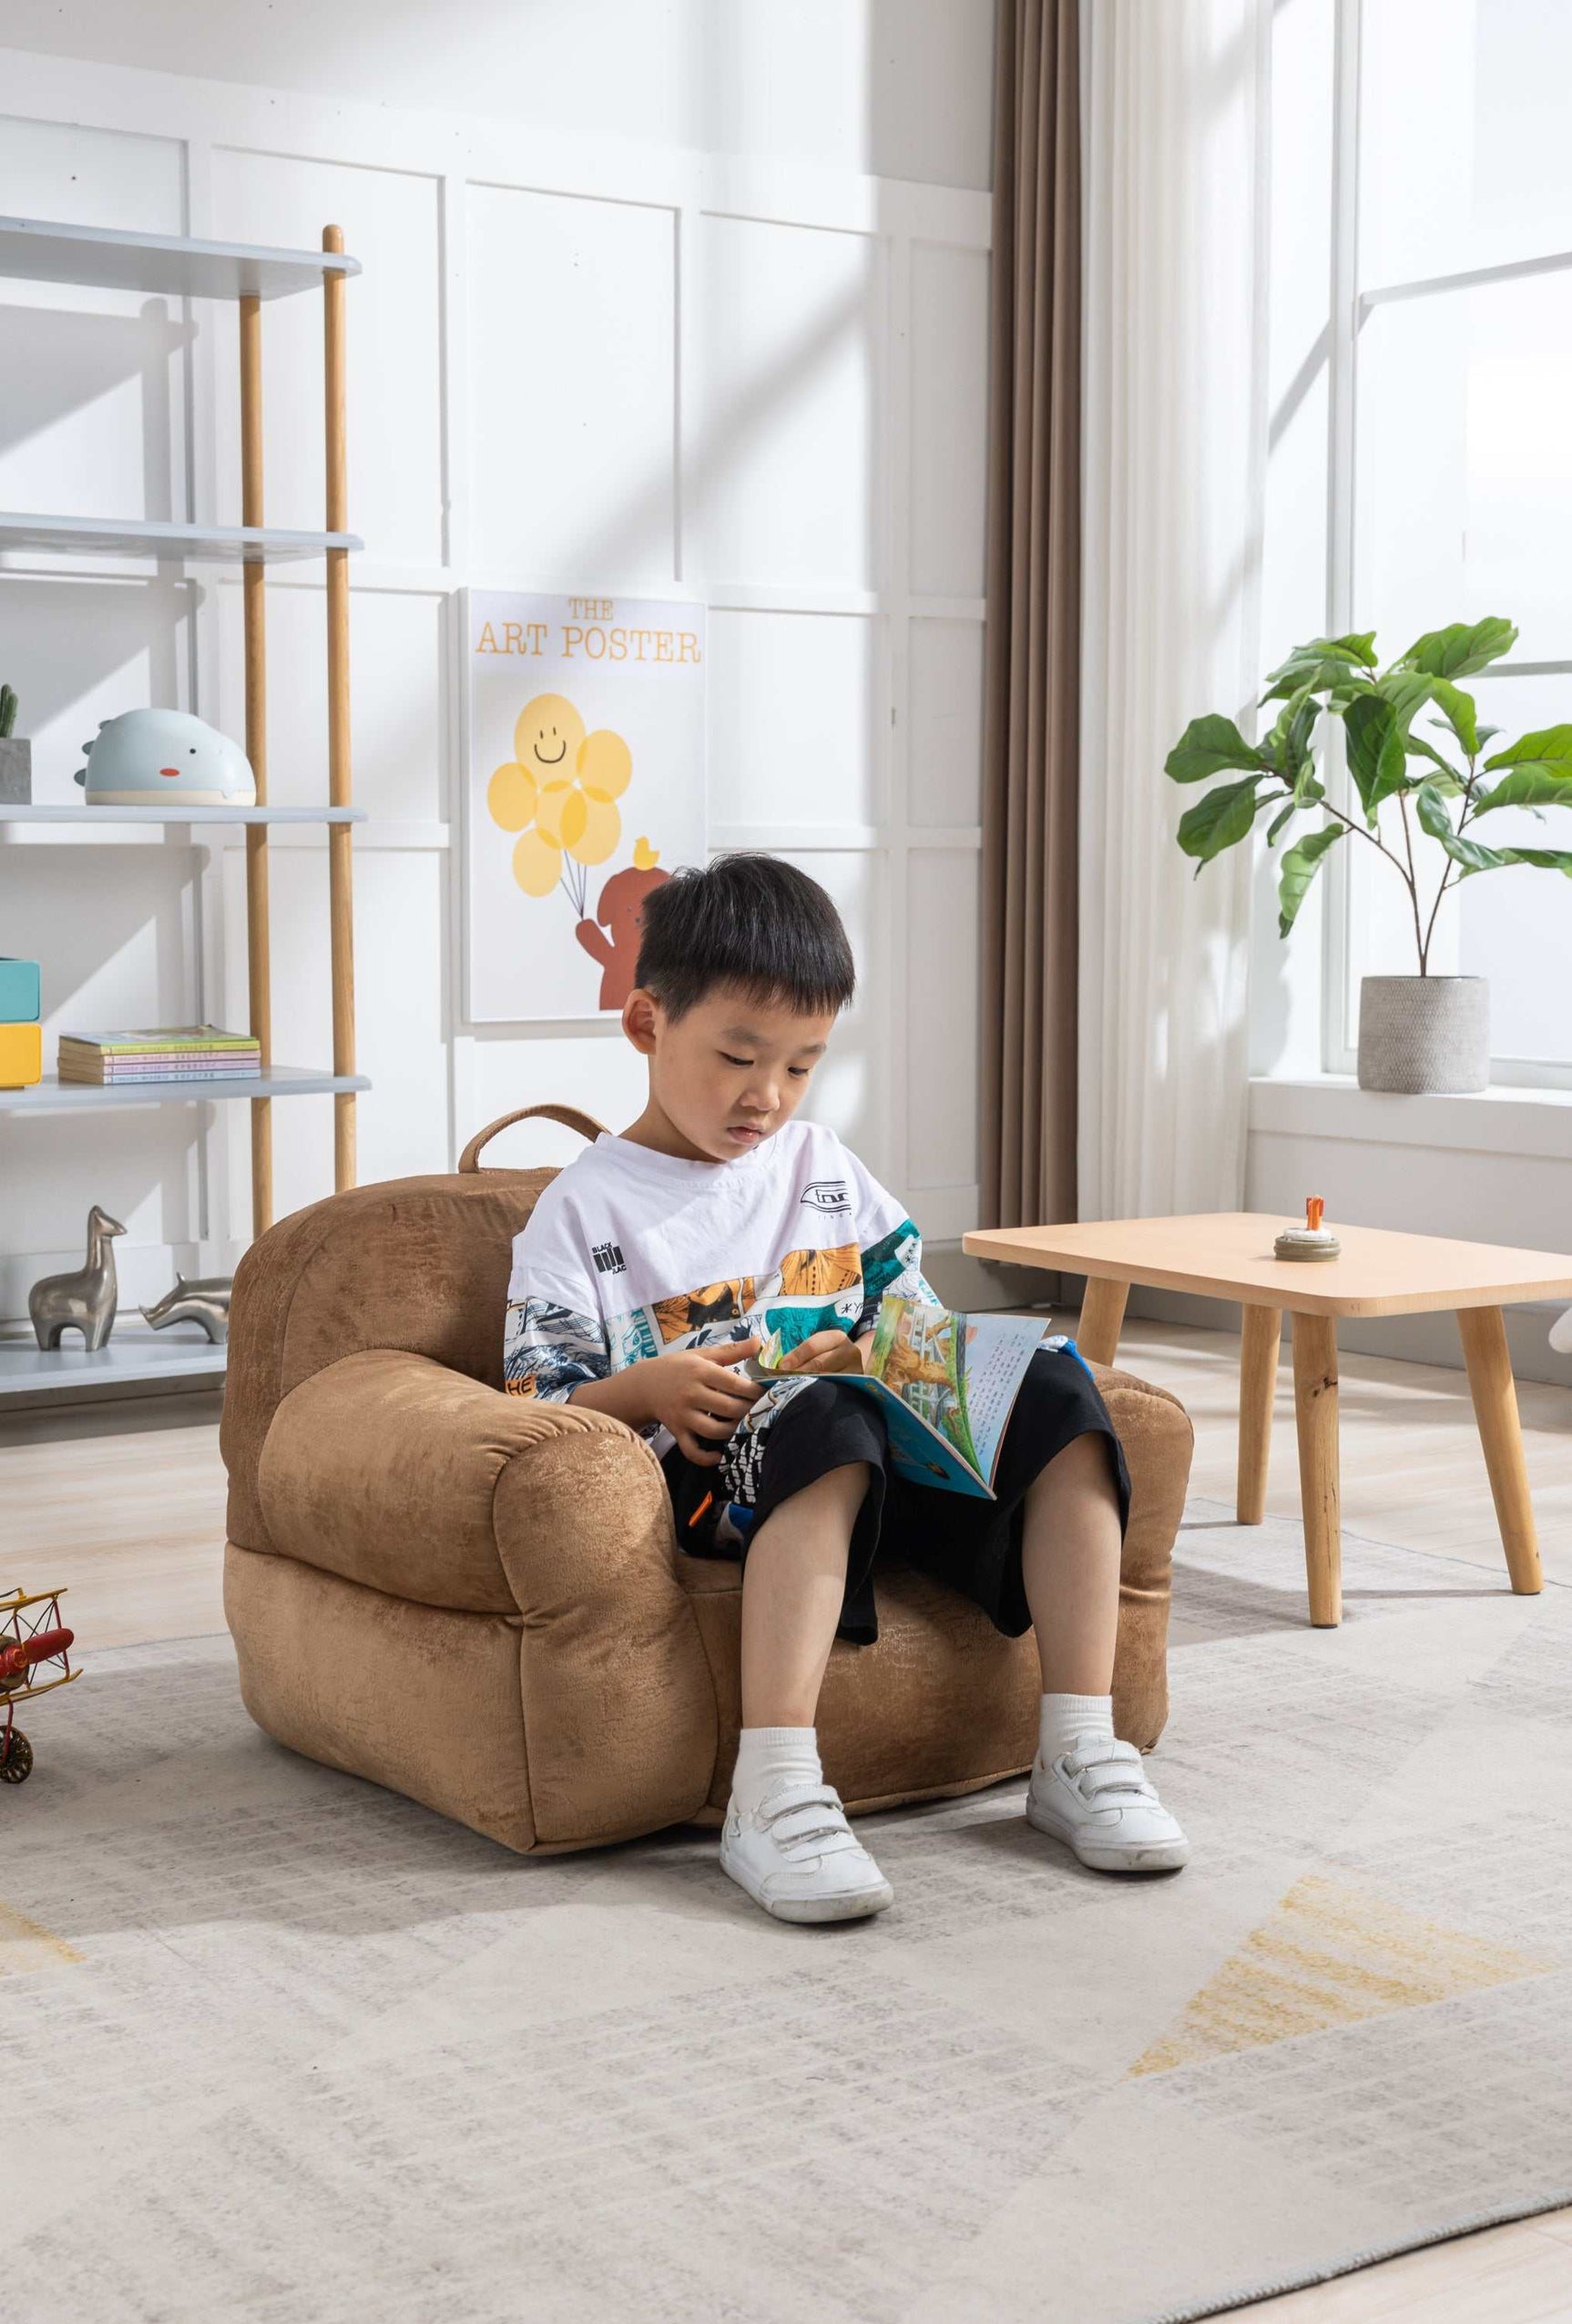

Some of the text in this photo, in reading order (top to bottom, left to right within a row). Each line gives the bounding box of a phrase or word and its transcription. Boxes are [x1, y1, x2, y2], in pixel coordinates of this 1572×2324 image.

[569, 598, 614, 621] THE
[475, 621, 701, 663] ART POSTER
[592, 1241, 612, 1253] BLACK
